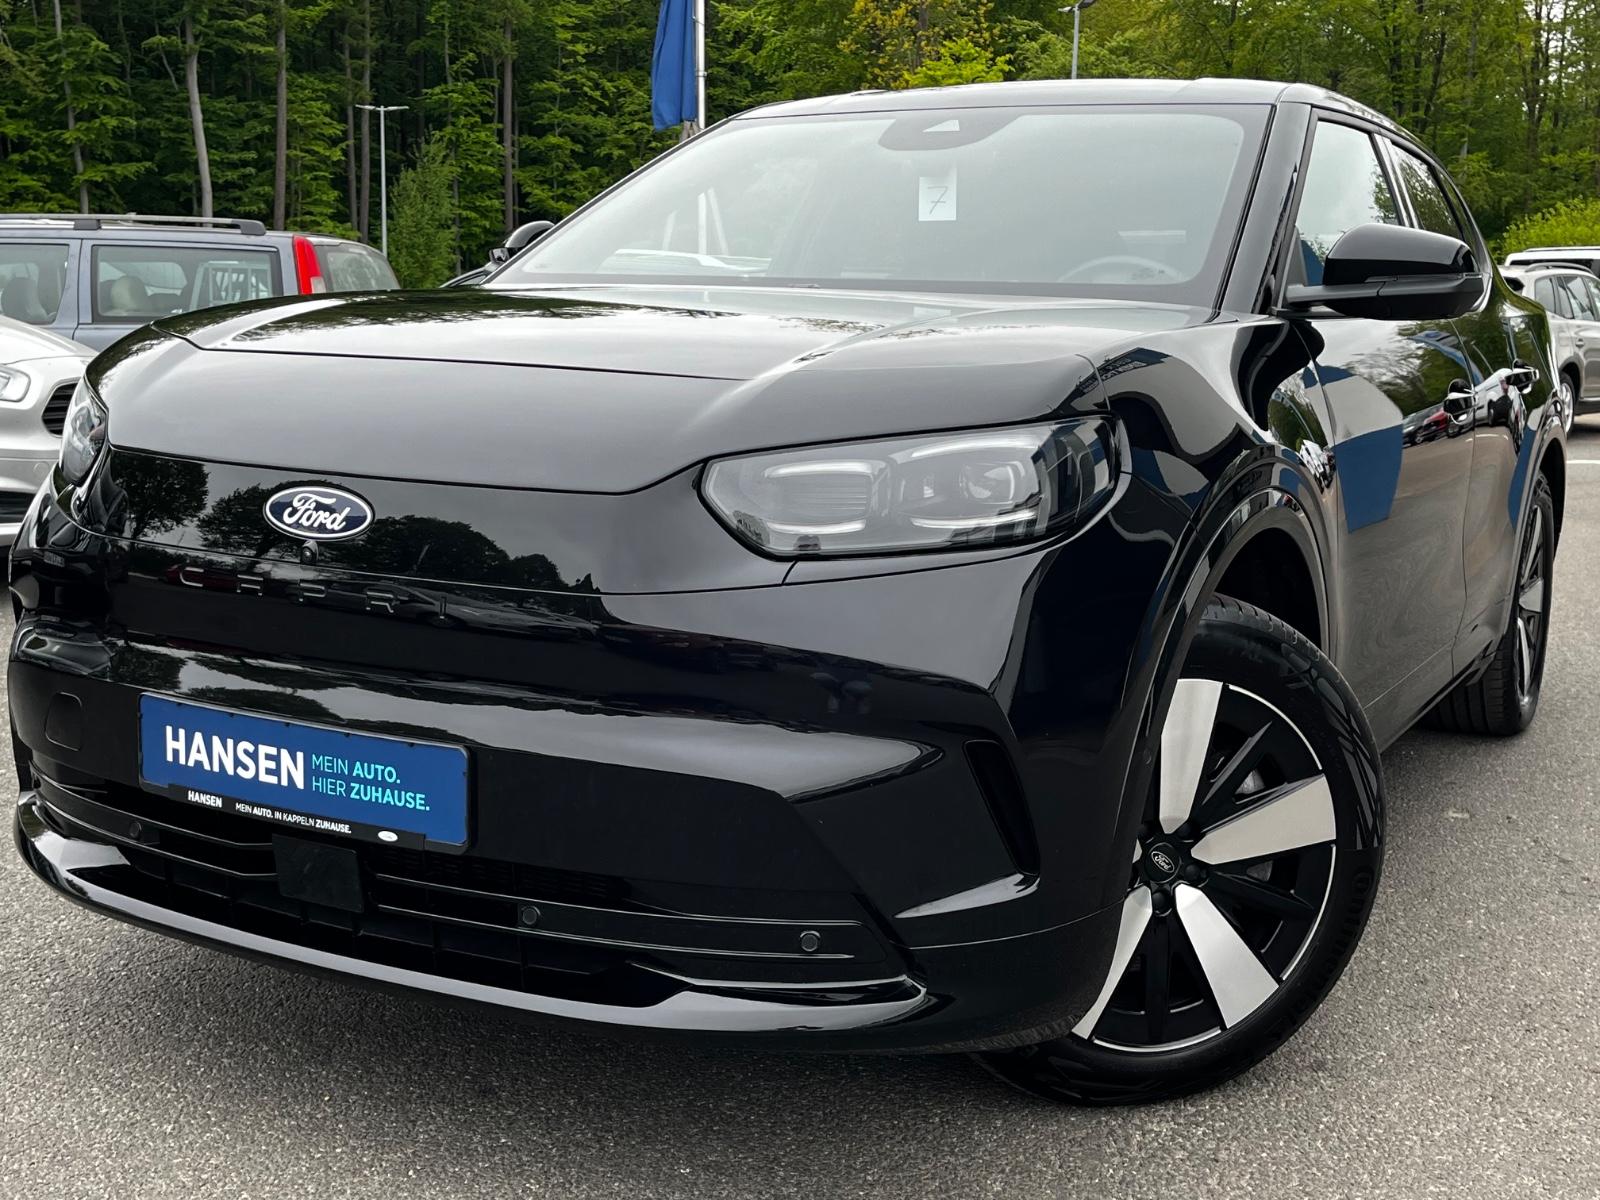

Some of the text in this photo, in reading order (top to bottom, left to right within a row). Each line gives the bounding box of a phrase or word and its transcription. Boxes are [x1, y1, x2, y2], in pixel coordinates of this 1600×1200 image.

[927, 185, 949, 215] 7
[283, 492, 352, 532] Ford
[164, 725, 305, 790] HANSEN
[311, 753, 401, 784] MEIN AUTO.
[187, 790, 223, 808] HANSEN
[312, 776, 430, 811] HIER ZUHAUSE.
[235, 802, 352, 834] MEIN AUTO. IN KAPPELN ZUHAUSE.
